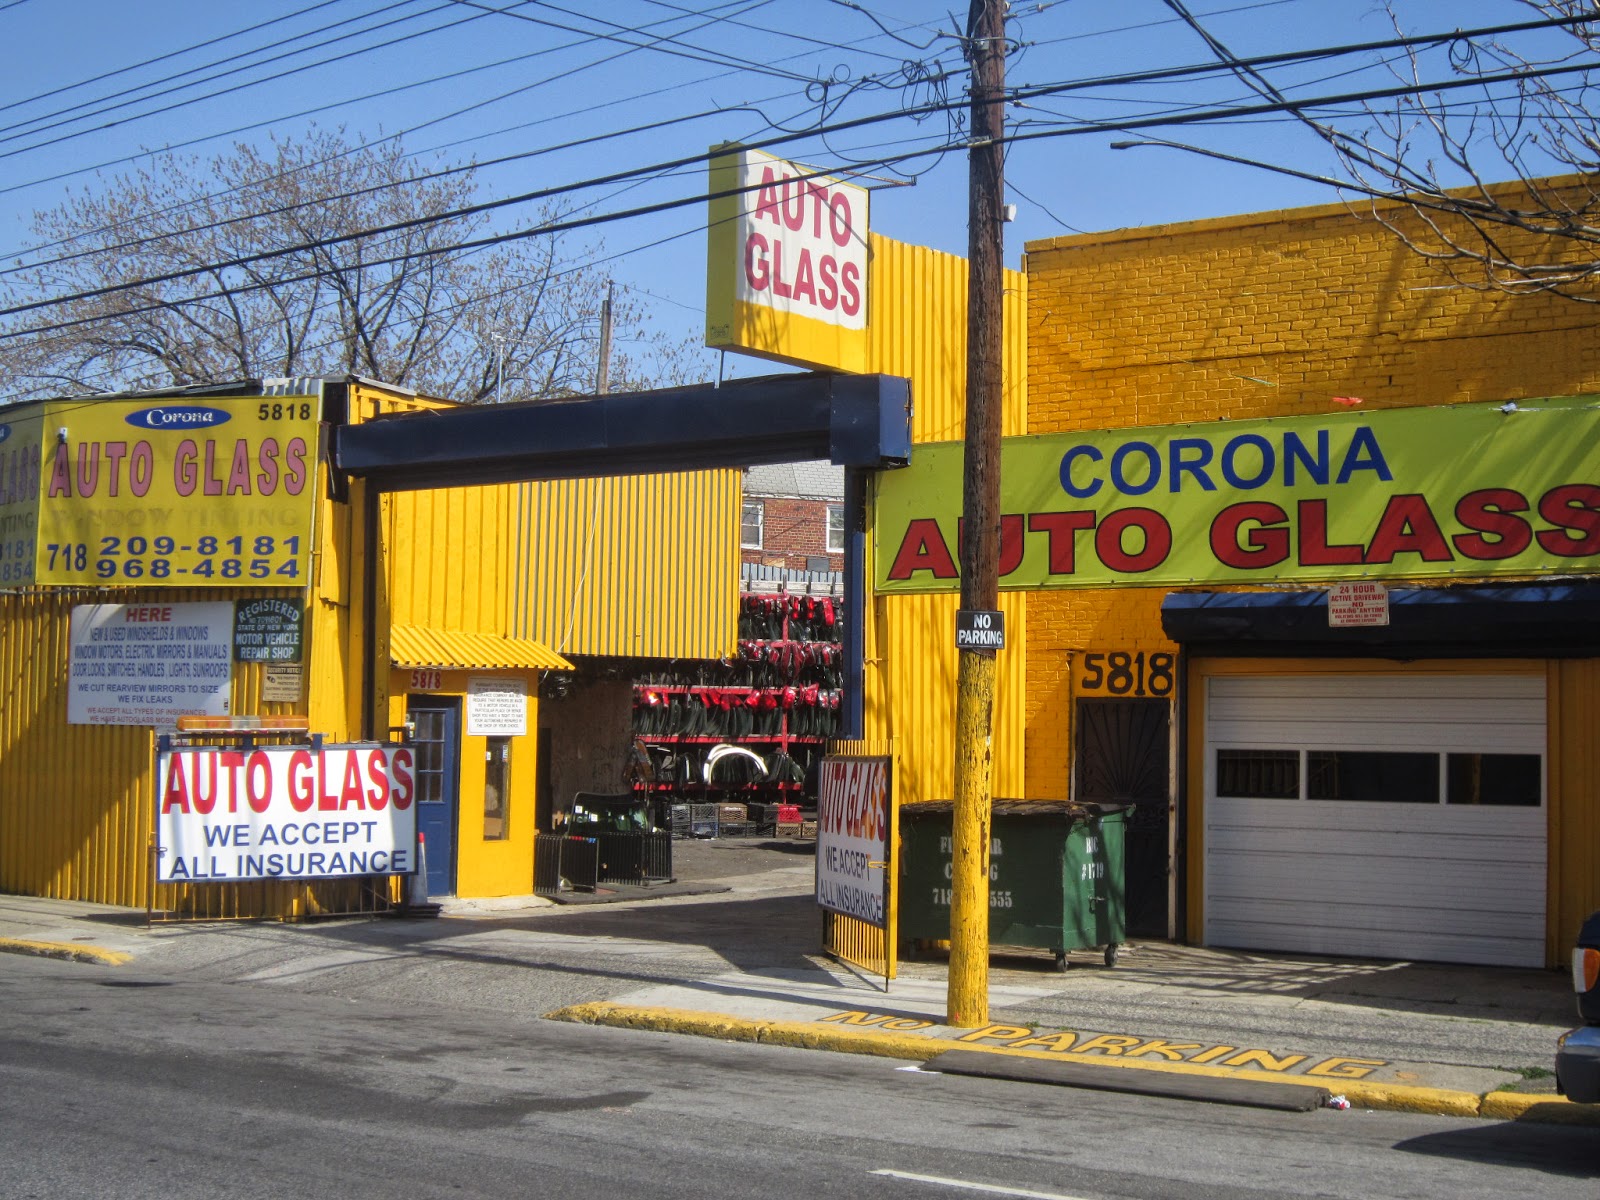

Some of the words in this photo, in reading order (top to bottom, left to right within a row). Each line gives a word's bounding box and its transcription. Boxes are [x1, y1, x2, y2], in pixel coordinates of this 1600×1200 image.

[755, 166, 852, 247] AUTO
[745, 232, 860, 316] GLASS
[147, 408, 214, 425] Corona
[258, 403, 311, 421] 5818
[48, 440, 154, 498] AUTO
[174, 437, 307, 497] GLASS
[1058, 426, 1393, 499] CORONA
[0, 444, 40, 507] LASS
[887, 506, 1172, 581] AUTO
[1208, 483, 1600, 569] GLASS
[100, 536, 300, 556] 209-8181
[47, 543, 87, 572] 718
[96, 558, 300, 579] 968-4854
[1353, 585, 1375, 593] HOUR
[126, 607, 172, 622] HERE
[238, 599, 300, 623] REGISTERED
[973, 614, 992, 629] NO
[90, 627, 103, 641] NEW
[104, 627, 109, 641] &
[110, 627, 126, 641] USED
[127, 626, 168, 641] WINDSHIELDS
[169, 626, 174, 640] &
[176, 626, 209, 641] WINDOWS
[235, 633, 263, 645] MOTOR
[265, 632, 300, 645] VEHICLE
[958, 629, 1003, 645] PARKING
[75, 645, 100, 659] WINDOW
[126, 645, 155, 659] ELECTRIC
[156, 645, 186, 659] MIRRORS
[187, 645, 192, 659] &
[194, 644, 227, 659] MANUALS
[240, 646, 270, 659] REPAIR
[271, 646, 295, 659] SHOP
[73, 663, 87, 677] DOOR
[193, 663, 228, 678] SUNROOFS
[411, 670, 442, 689] 5818
[1081, 652, 1173, 696] 5818
[78, 684, 89, 692] WE
[90, 684, 106, 692] CUT
[106, 684, 146, 693] REARVIEW
[149, 684, 185, 693] MIRRORS
[188, 685, 198, 693] TO
[200, 685, 219, 693] SIZE
[118, 695, 130, 703] WE
[132, 695, 144, 703] FIX
[146, 695, 173, 704] LEAKS
[87, 707, 97, 715] WE
[98, 707, 120, 715] ACCEPT
[166, 708, 207, 716] INSURANCES
[89, 716, 100, 724] WE
[117, 716, 154, 724] AUTOGLASS
[155, 716, 176, 724] MOBIL
[161, 750, 273, 815] AUTO
[287, 748, 413, 812] GLASS
[820, 761, 847, 836] AUTO
[847, 762, 887, 843] GLASS
[203, 824, 250, 847] WE
[259, 821, 377, 846] ACCEPT
[170, 856, 226, 878] ALL
[237, 850, 407, 877] INSURANCE
[825, 844, 838, 872] WE
[839, 848, 871, 881] ACCEPT
[820, 878, 836, 907] ALL
[836, 882, 882, 925] INSURANCE
[820, 1010, 937, 1031] NO
[957, 1023, 1387, 1080] PARKING
